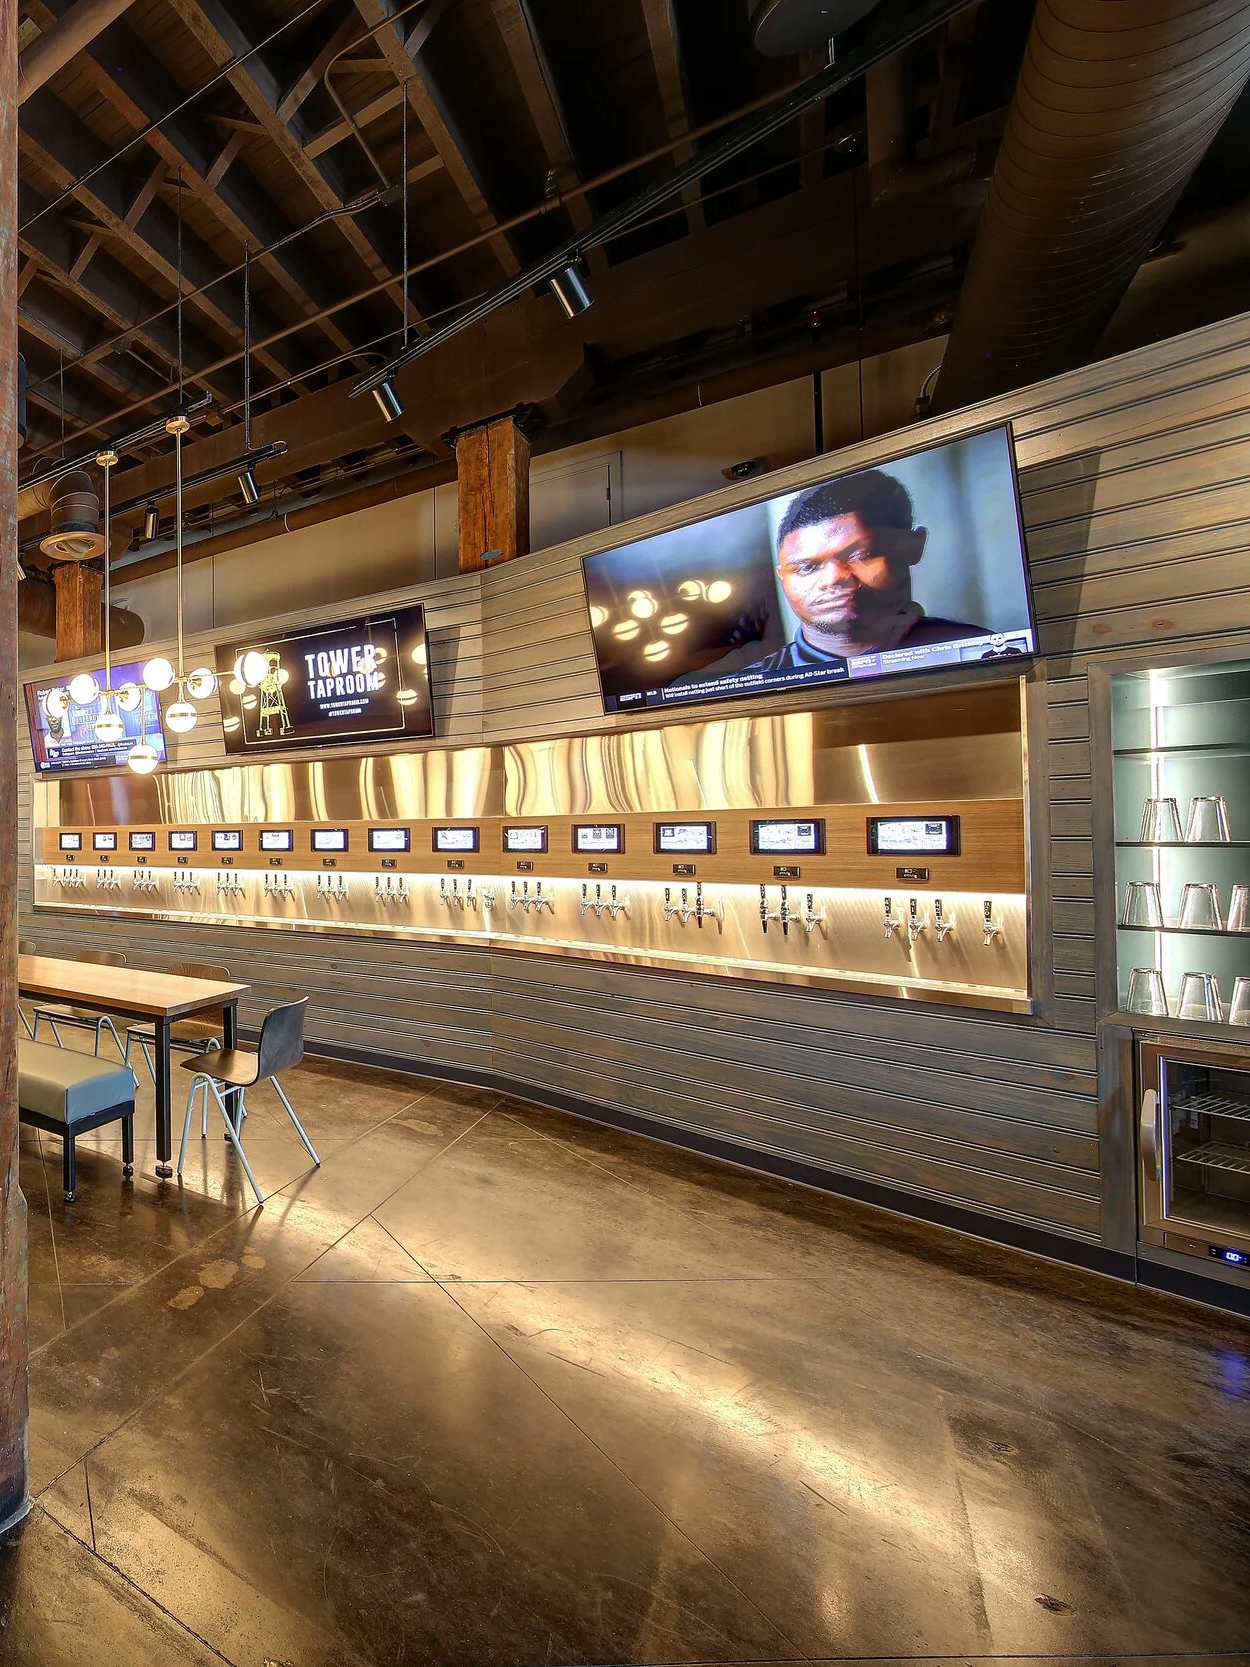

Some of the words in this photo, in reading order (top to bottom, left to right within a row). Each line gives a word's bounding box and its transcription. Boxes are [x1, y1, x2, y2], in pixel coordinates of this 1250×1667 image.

[882, 650, 913, 660] Declared
[914, 648, 931, 656] with
[932, 645, 951, 653] Chris
[304, 644, 378, 678] TOWER
[805, 670, 826, 678] All-Star
[307, 671, 379, 699] TAPROOM
[664, 685, 691, 693] Nationals
[699, 680, 719, 688] extend
[720, 677, 738, 685] safety
[620, 692, 642, 702] ESPN
